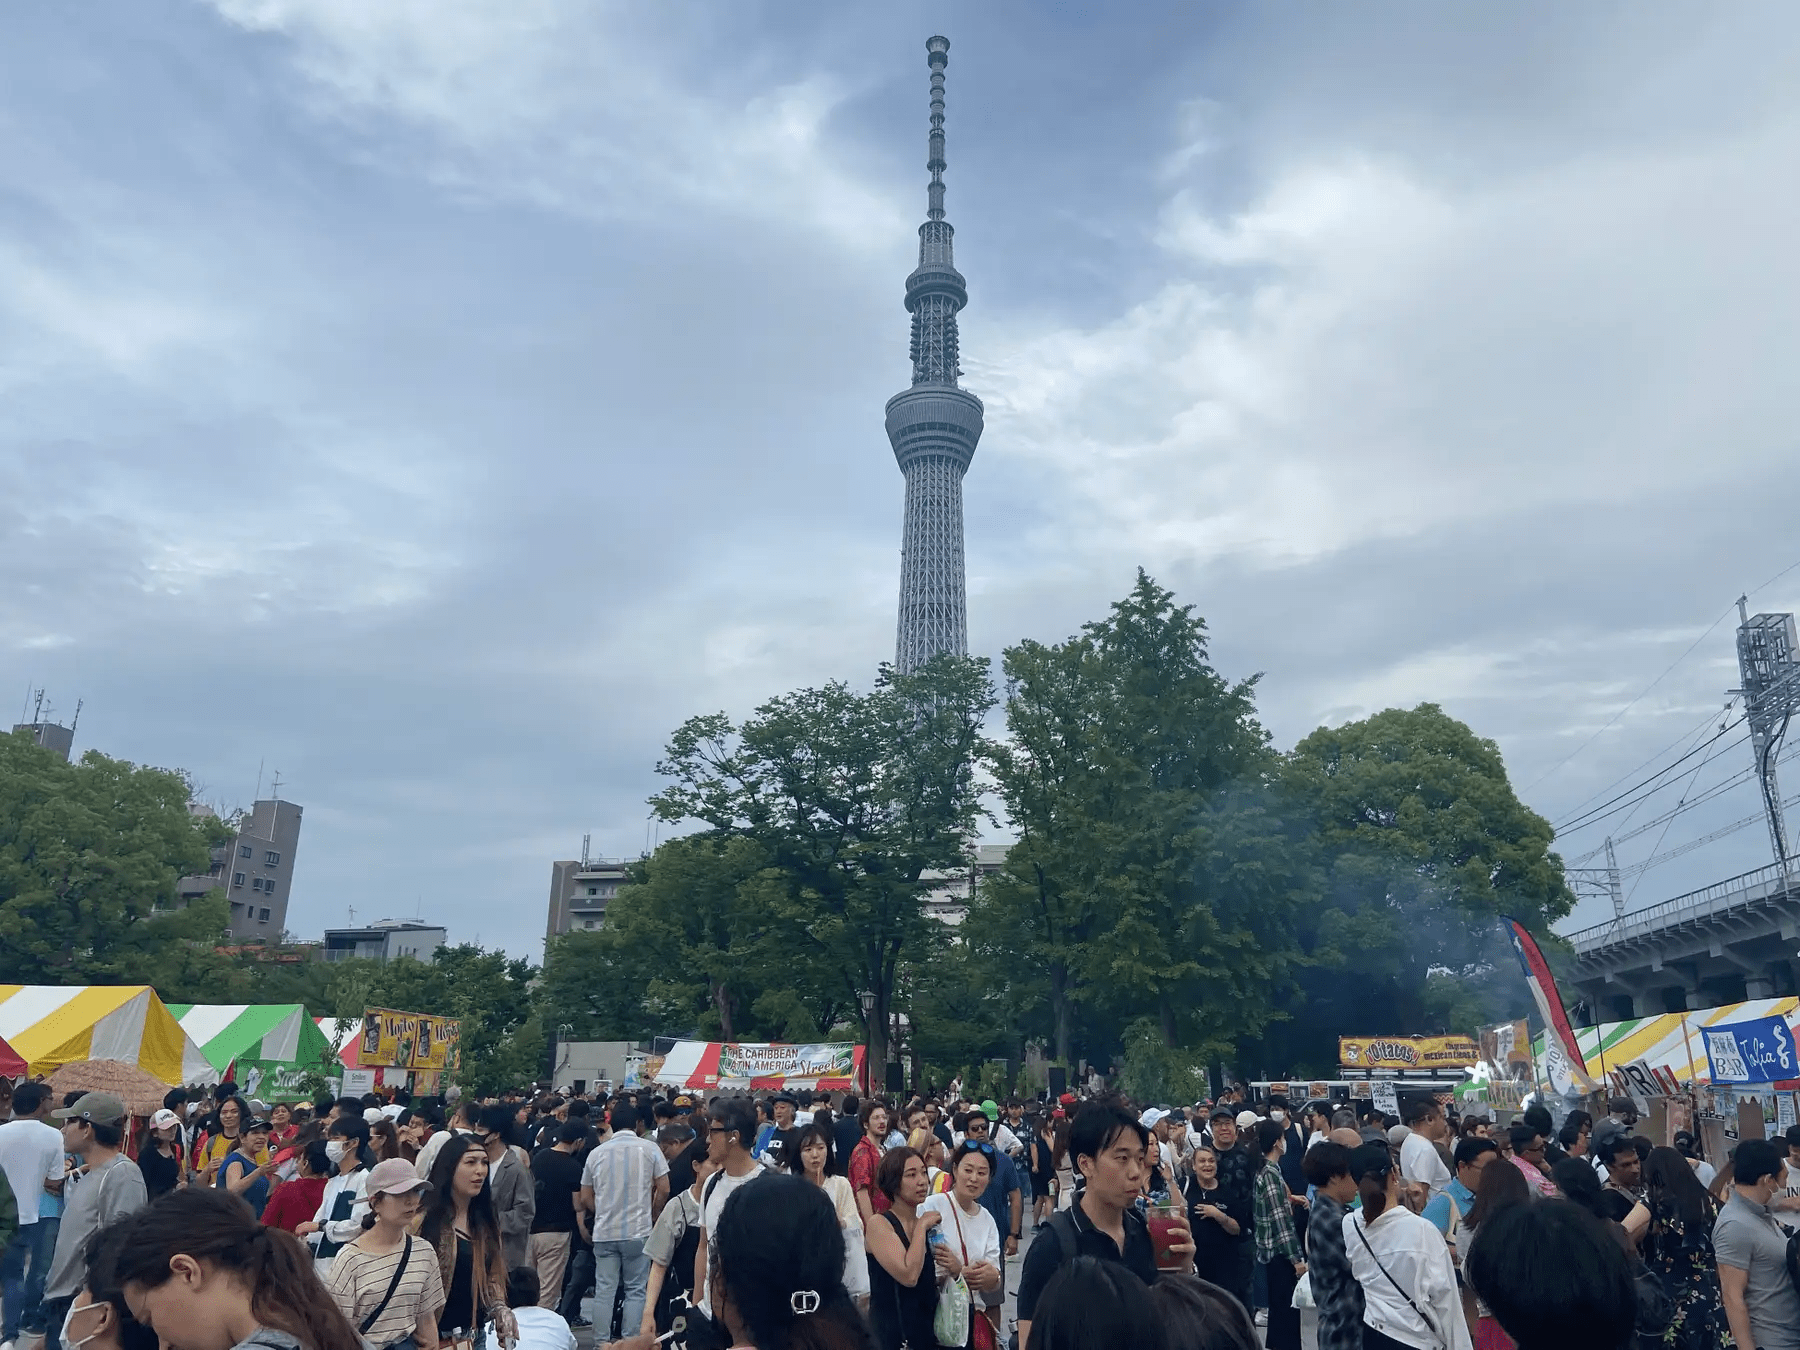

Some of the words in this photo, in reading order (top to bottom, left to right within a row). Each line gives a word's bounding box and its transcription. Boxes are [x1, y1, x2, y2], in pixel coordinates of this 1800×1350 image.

[726, 1048, 743, 1059] THE
[745, 1048, 799, 1059] CARIBBEAN
[724, 1060, 751, 1070] LATIN
[753, 1060, 798, 1071] AMERICA
[800, 1055, 840, 1076] Street
[1713, 1057, 1747, 1076] BAR
